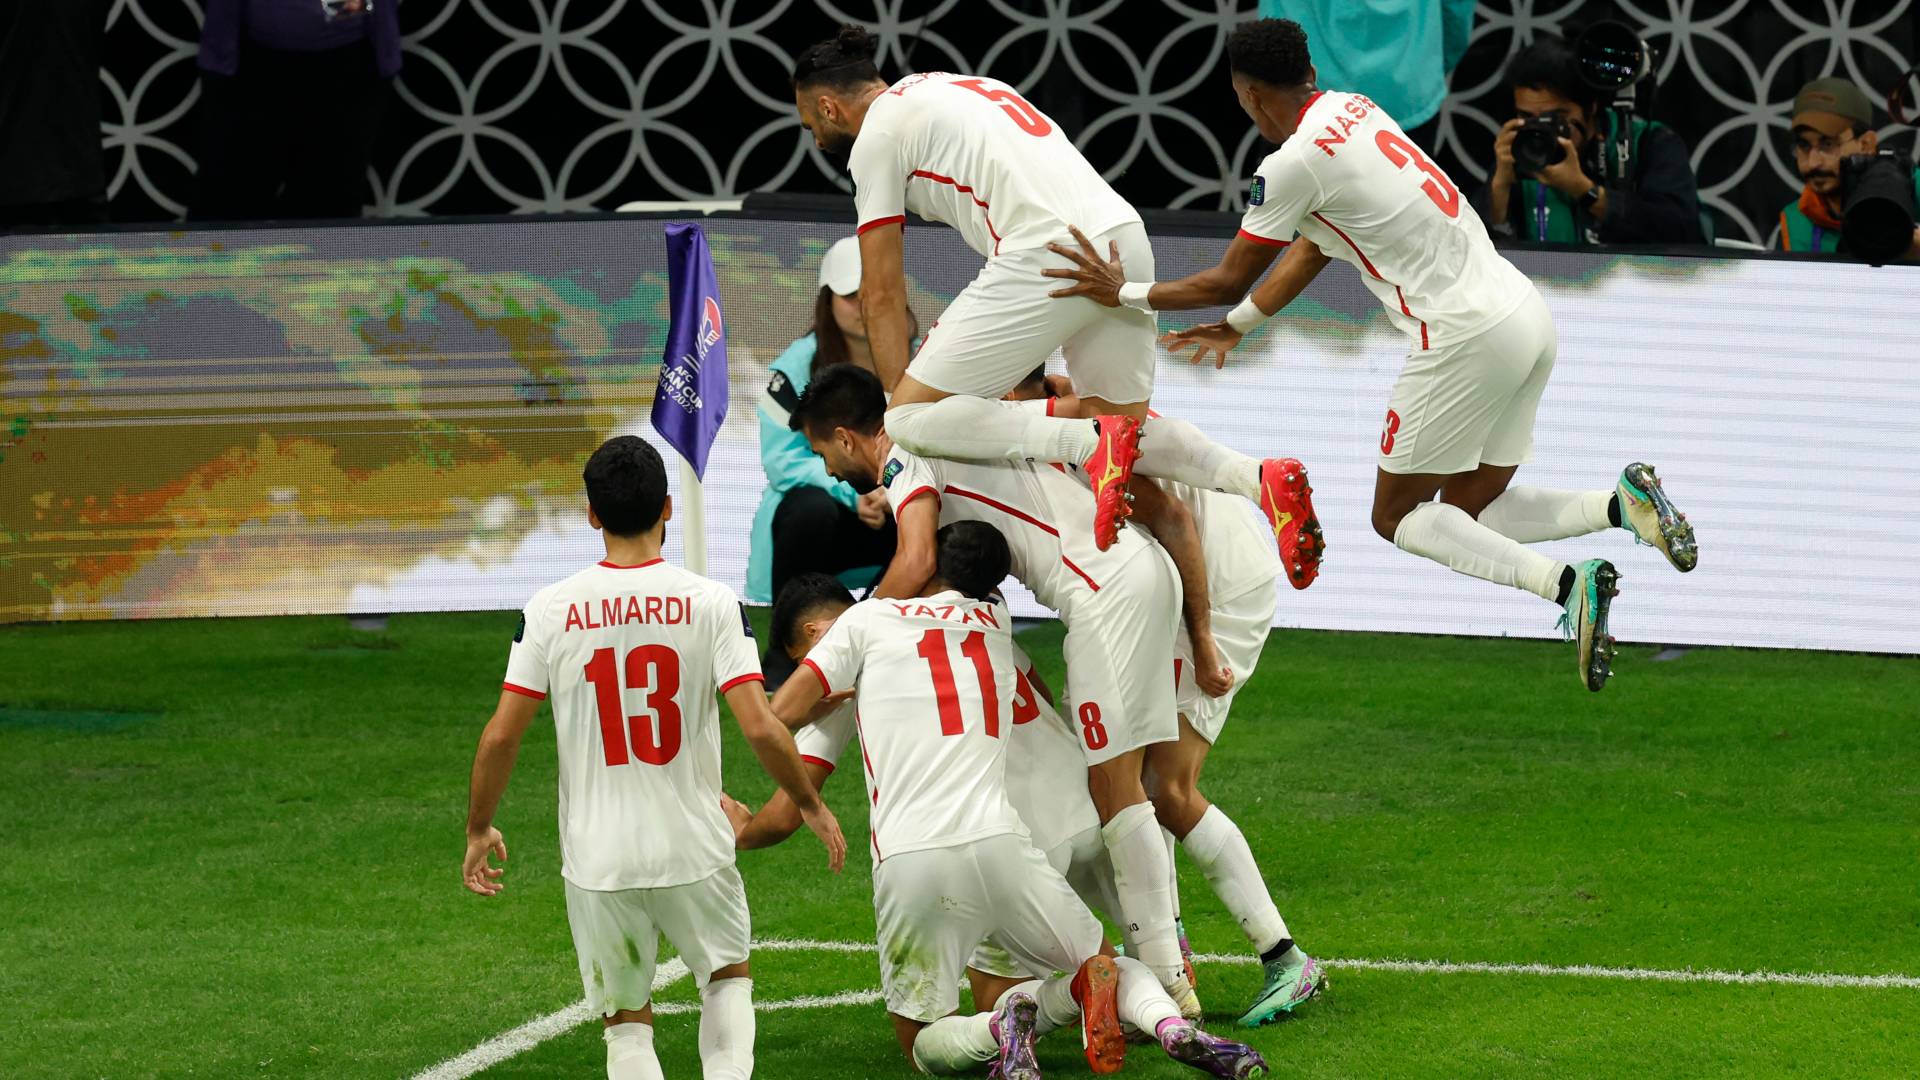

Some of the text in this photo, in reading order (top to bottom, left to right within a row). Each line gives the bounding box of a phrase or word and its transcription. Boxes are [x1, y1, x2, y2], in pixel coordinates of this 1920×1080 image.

[946, 79, 1053, 137] 5
[1375, 130, 1460, 219] 3
[674, 365, 694, 383] AFC
[1380, 409, 1401, 455] 3
[565, 596, 692, 632] ALMARDI
[583, 643, 682, 766] 13
[916, 628, 1000, 738] 11
[1078, 701, 1109, 750] 8
